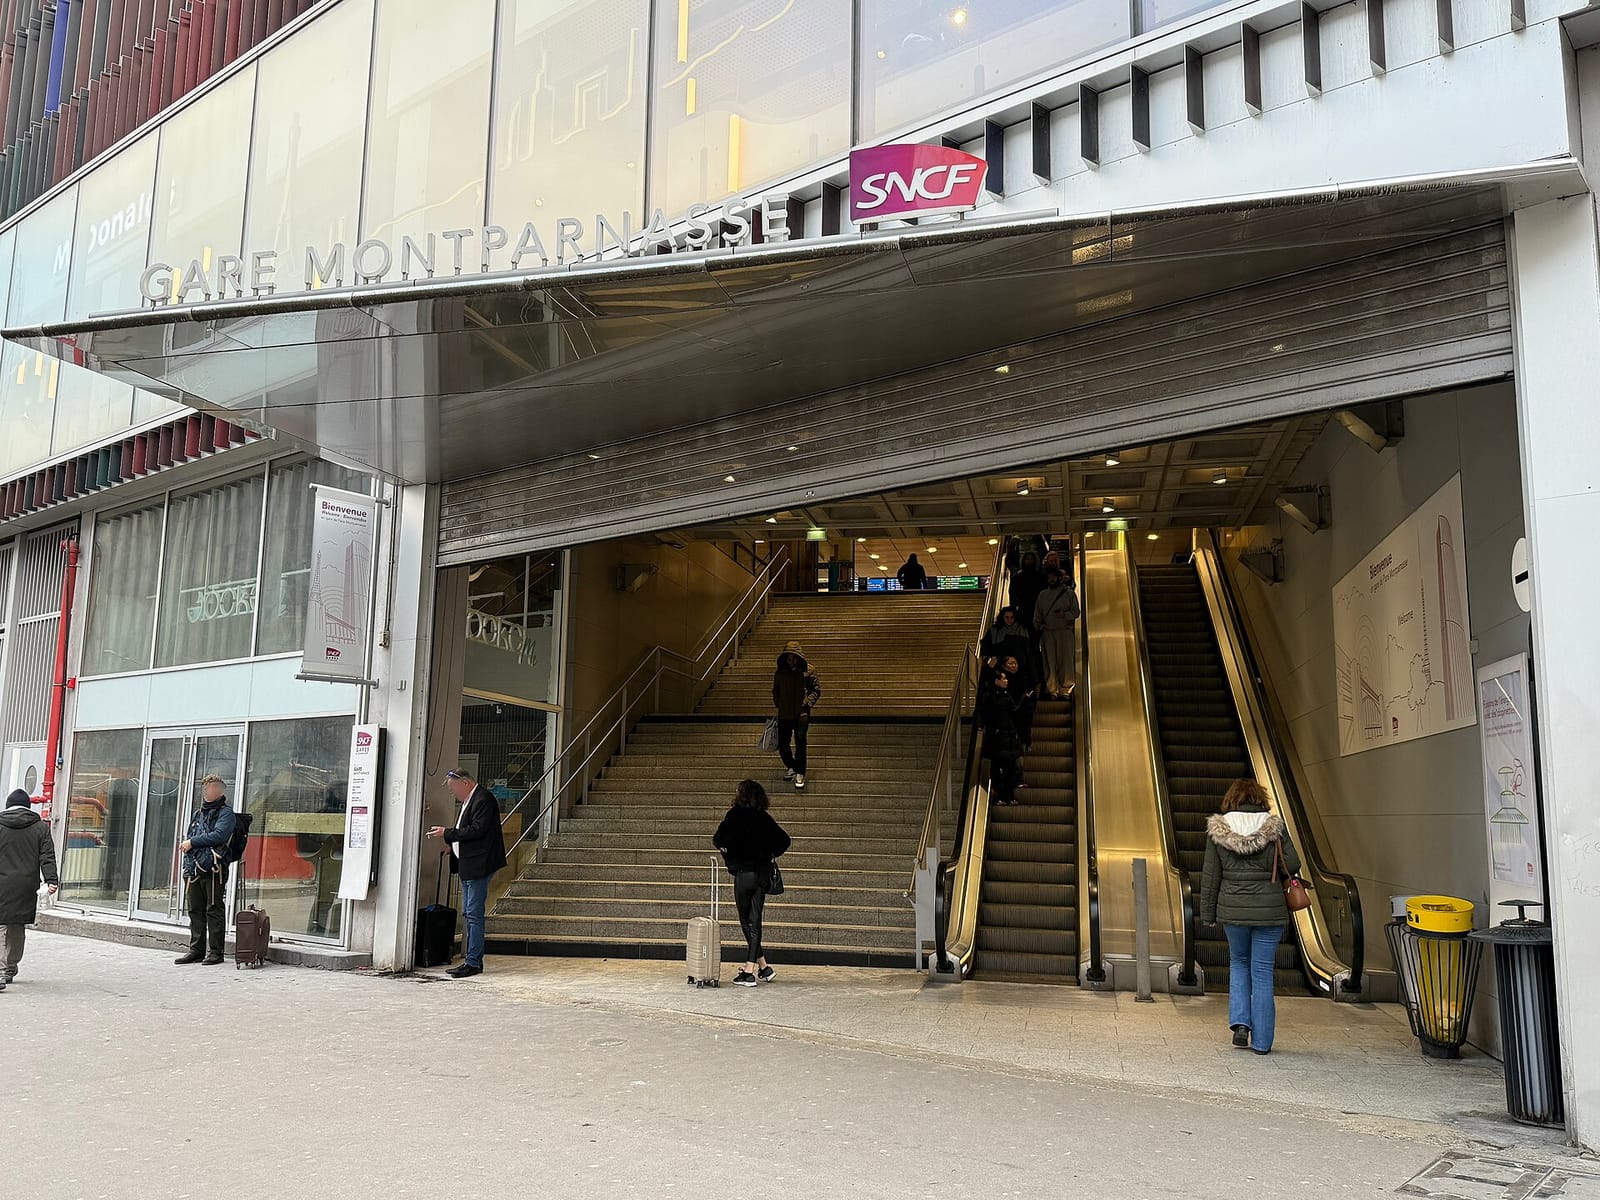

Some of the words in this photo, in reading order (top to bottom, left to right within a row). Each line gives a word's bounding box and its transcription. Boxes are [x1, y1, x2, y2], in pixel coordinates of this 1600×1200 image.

[856, 163, 977, 209] SNCF
[140, 250, 278, 301] GARE
[304, 194, 790, 285] MONTPARNASSE
[321, 501, 368, 518] Bienvenue
[1369, 553, 1393, 580] Bienvenue
